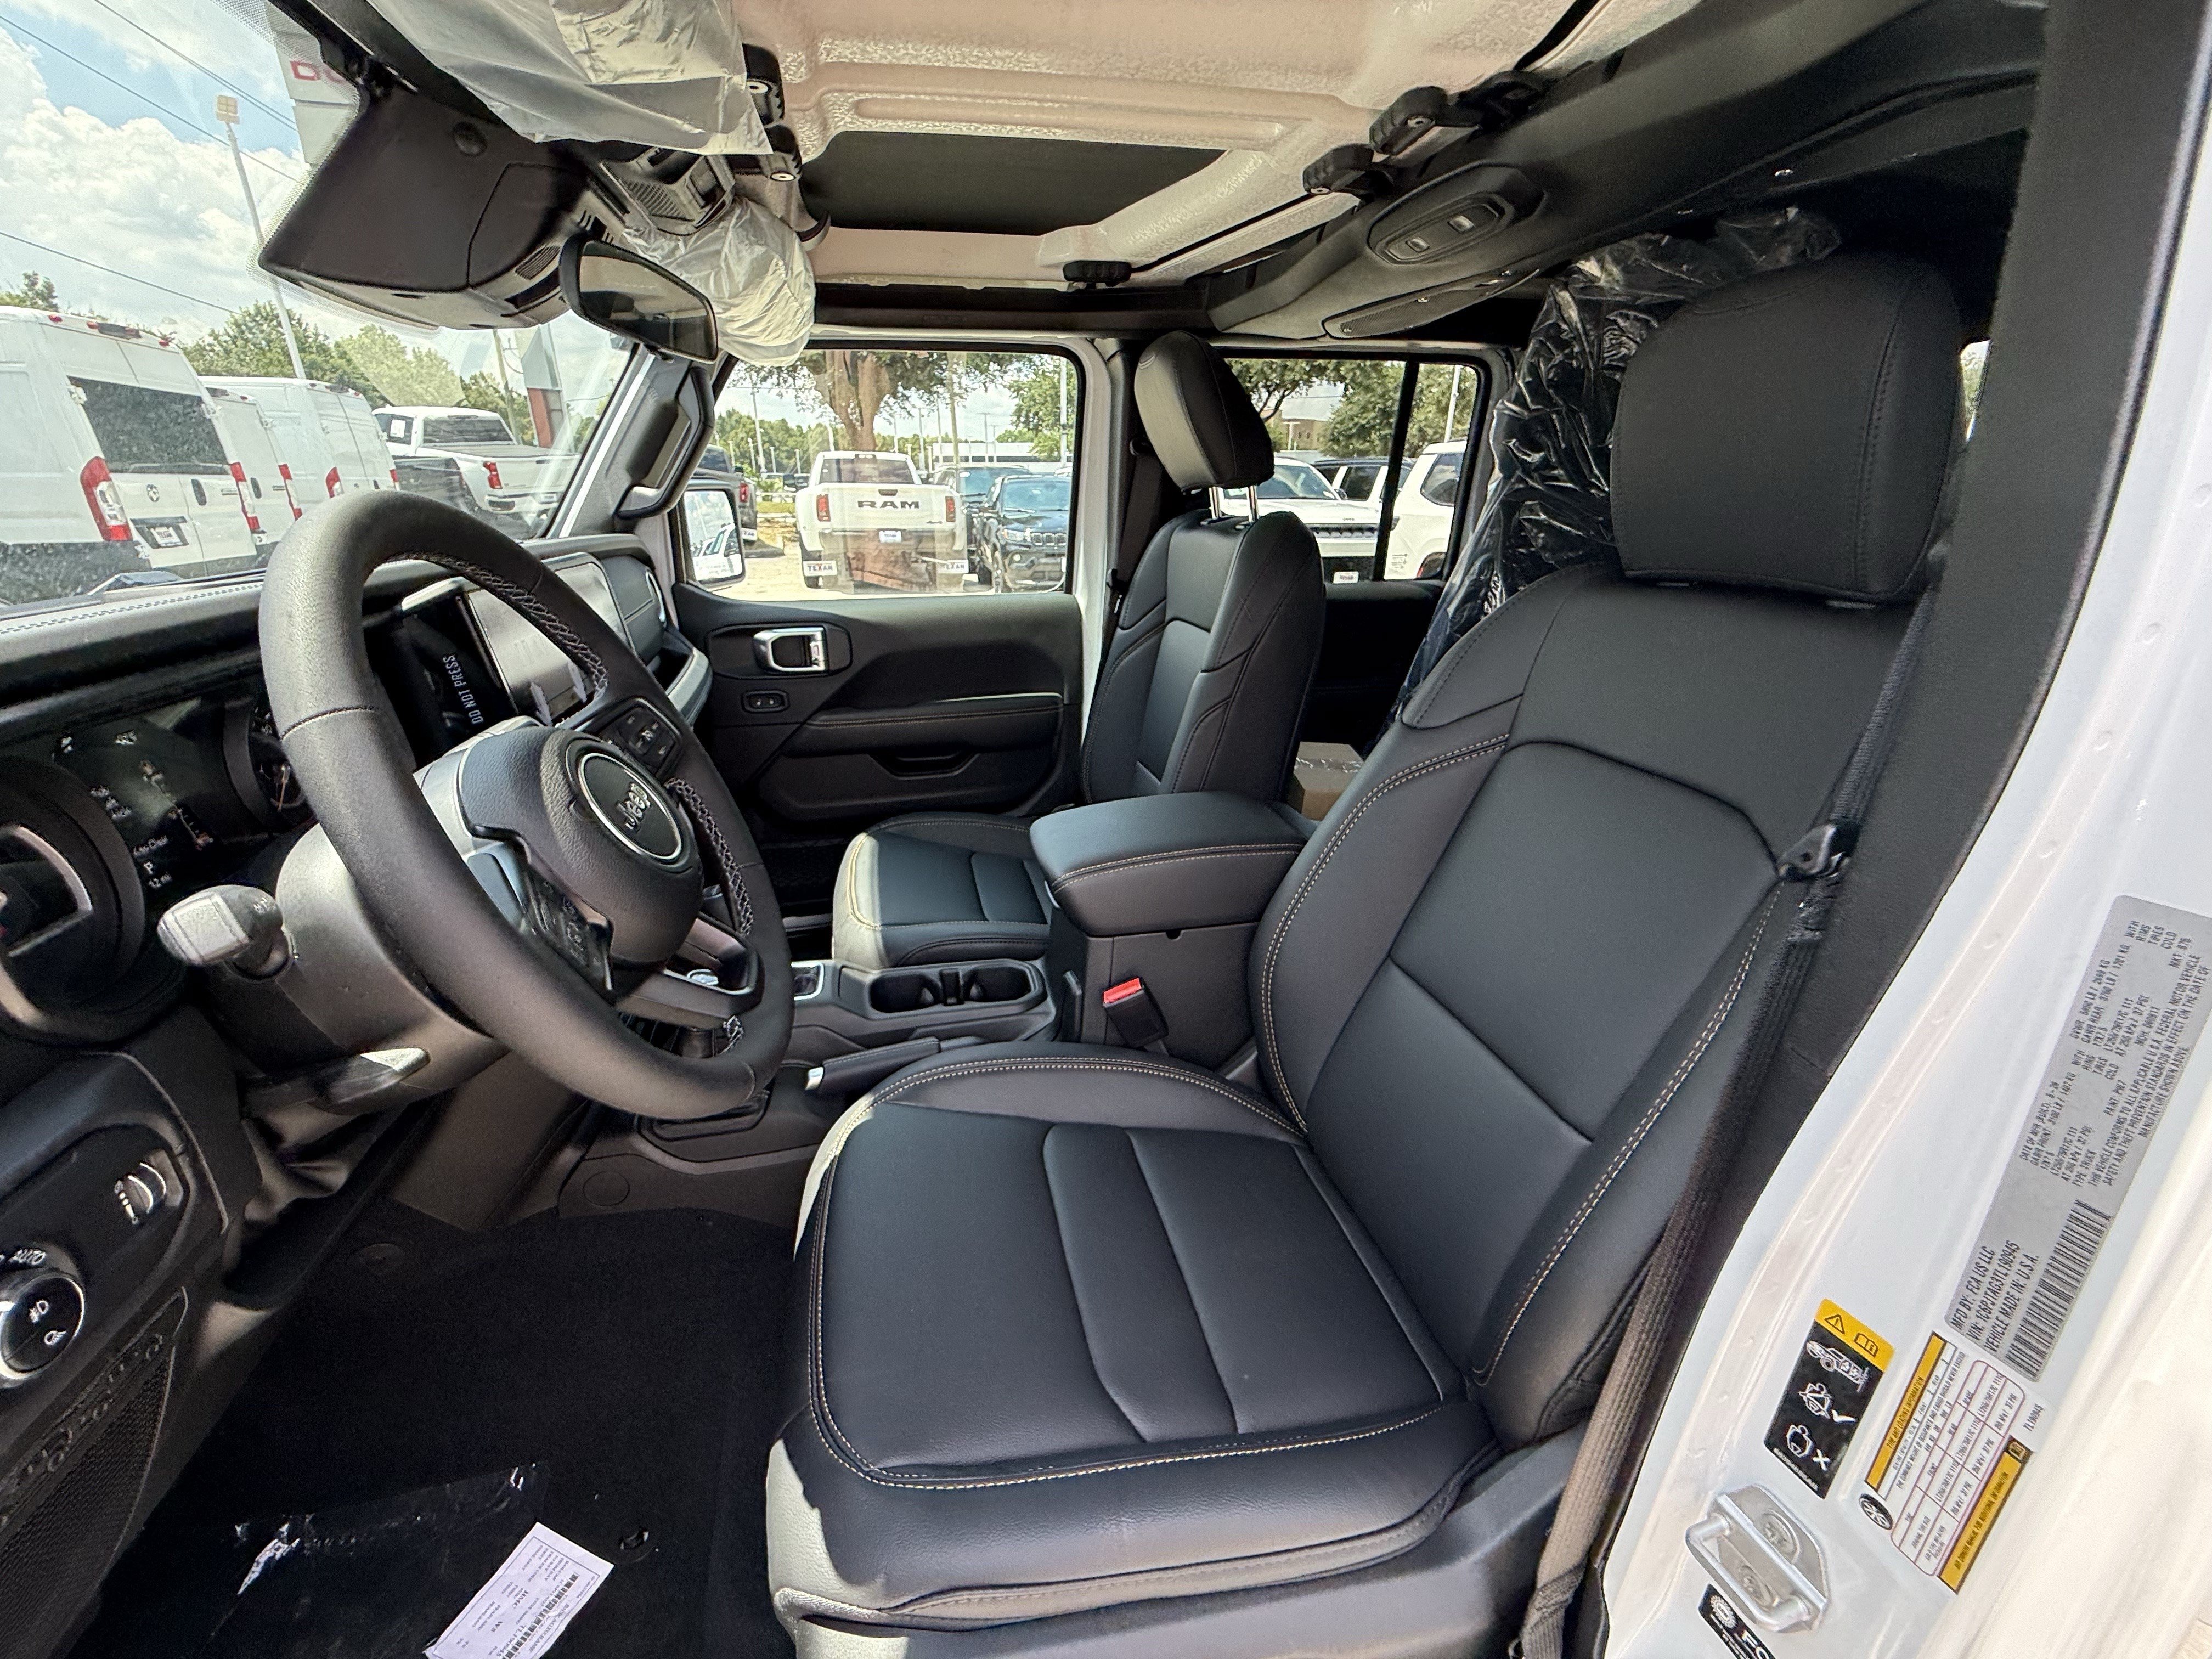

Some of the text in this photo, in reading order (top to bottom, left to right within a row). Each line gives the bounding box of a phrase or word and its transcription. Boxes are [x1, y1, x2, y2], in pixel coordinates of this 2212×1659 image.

[857, 500, 919, 509] RAM
[441, 654, 485, 724] DO NOT PRESS
[617, 783, 651, 830] Jeep
[2124, 919, 2141, 939] WITH
[2147, 924, 2165, 945] TIRES
[2179, 953, 2202, 982] VEHICLE
[2113, 1046, 2126, 1057] AT
[2159, 930, 2177, 949] COLD
[2168, 981, 2189, 1006] MOTOR
[2154, 1006, 2178, 1036] FEDERAL
[2070, 1048, 2086, 1066] WITH
[2103, 1062, 2119, 1080] COLD
[2101, 964, 2212, 1186] SAFETY AND THEFT PREVENTION STANDARDS IN EFFECT ON THE DATE OF
[2129, 1056, 2155, 1094] APPLICABLE
[2119, 1104, 2132, 1116] TO
[2123, 1093, 2138, 1107] ALL
[2137, 1091, 2168, 1138] MANUFACTURE
[2158, 1066, 2180, 1093] SHOWN
[2104, 1114, 2128, 1149] CONFORMS
[2079, 1148, 2096, 1170] TRUCK
[2094, 1147, 2113, 1173] VEHICLE
[2087, 1171, 2102, 1188] THIS
[8, 1249, 46, 1265] AUTO
[1950, 1244, 1995, 1331] MFD BY: FCA US LLC
[1966, 1238, 2021, 1343] VIN: 1C6PJTAG3TL190945
[1983, 1248, 2039, 1355] VEHICLE MADE IN: U.S.A.
[1891, 1425, 1900, 1438] AND
[1904, 1375, 1925, 1409] INFORMATION
[2022, 1402, 2044, 1432] TL190945
